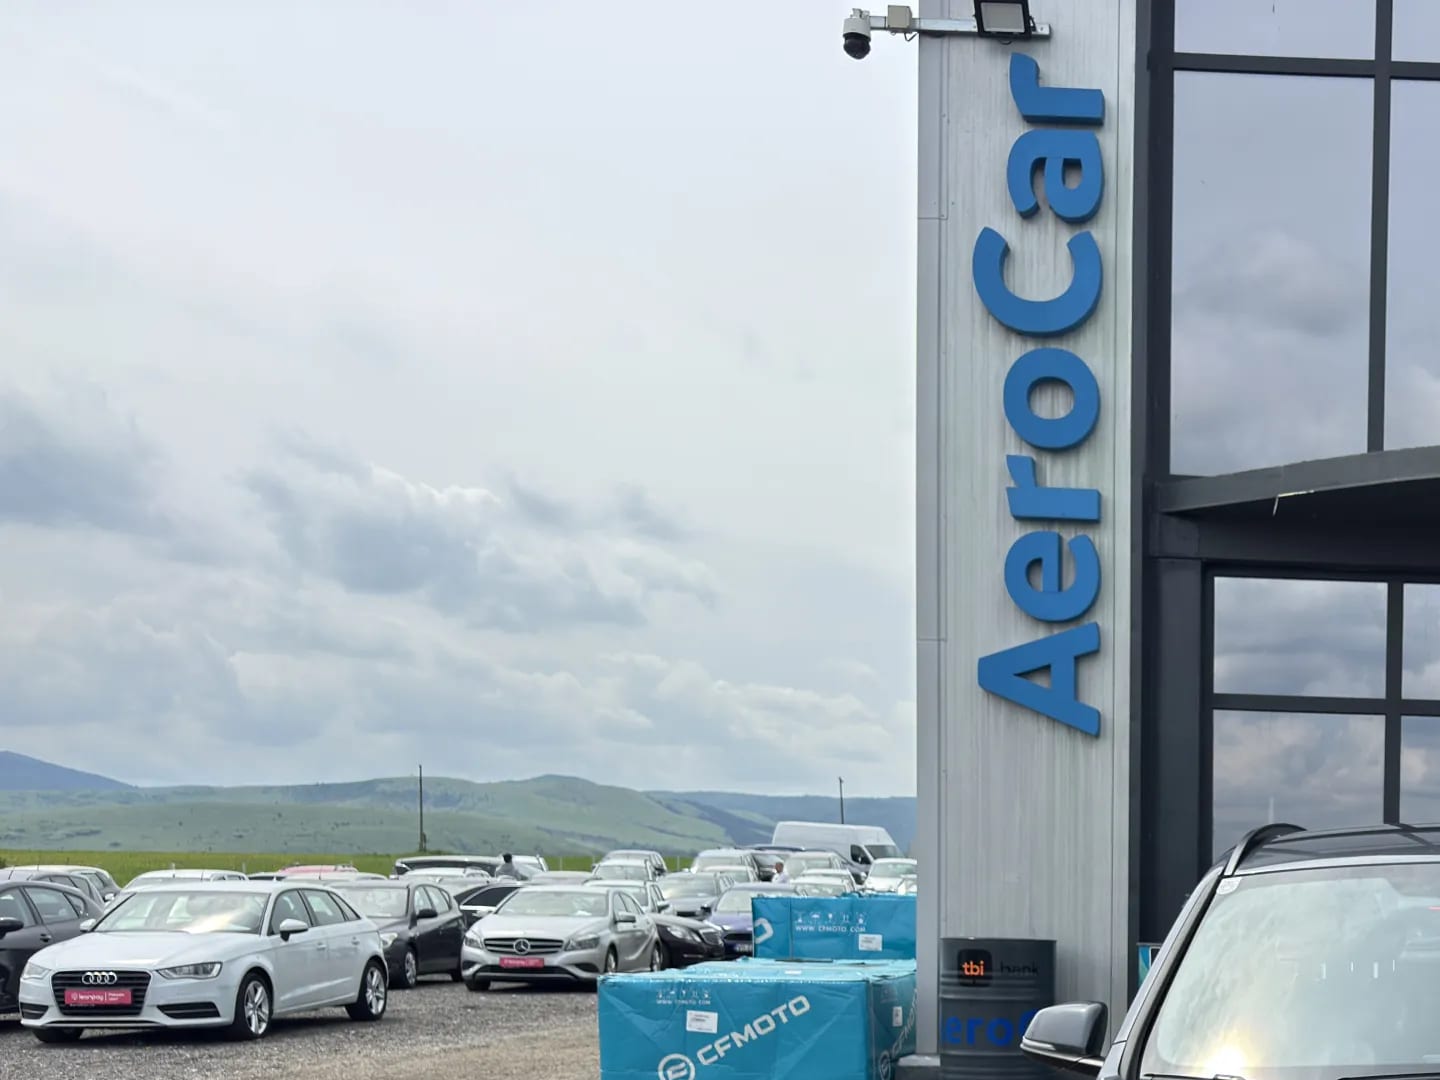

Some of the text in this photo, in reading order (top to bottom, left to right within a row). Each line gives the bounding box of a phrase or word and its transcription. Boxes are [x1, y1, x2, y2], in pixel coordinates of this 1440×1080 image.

[972, 52, 1104, 738] AeroCar
[961, 960, 984, 976] tbi
[697, 995, 811, 1065] CFMOTO
